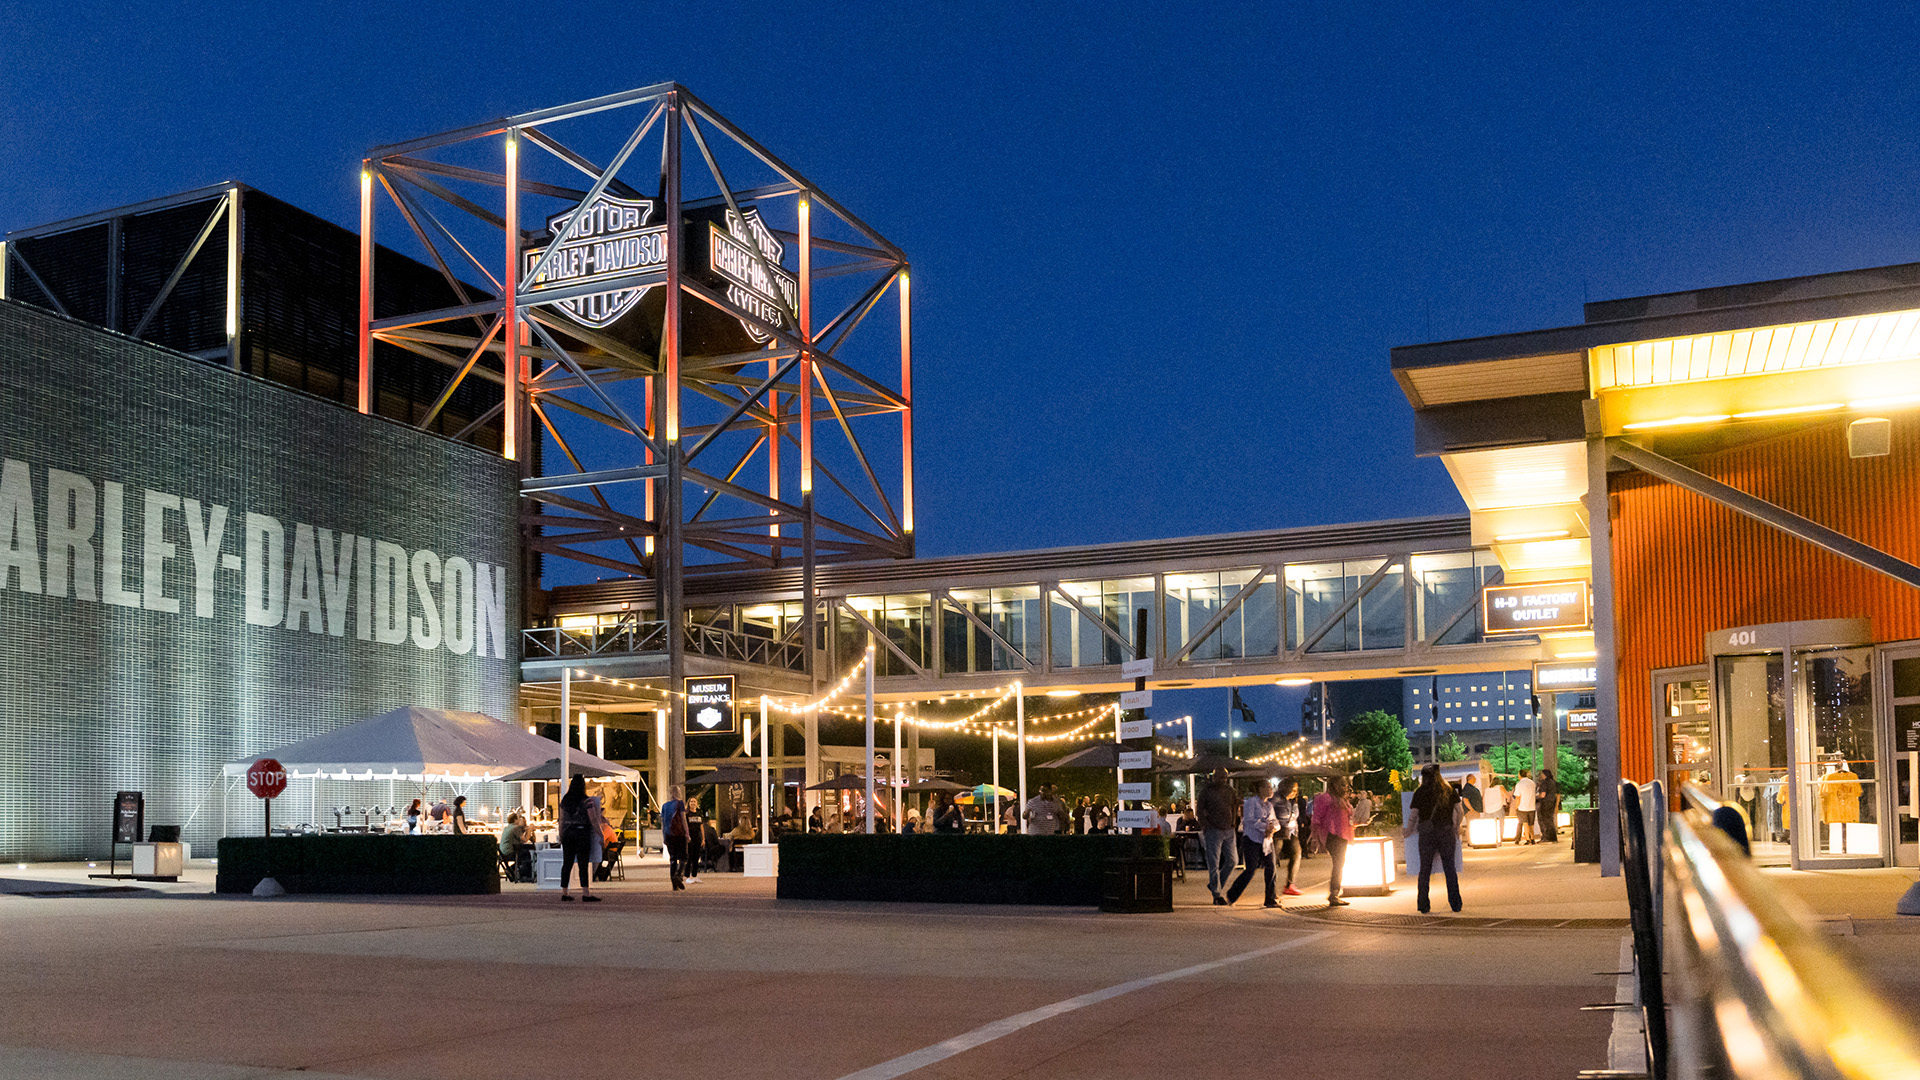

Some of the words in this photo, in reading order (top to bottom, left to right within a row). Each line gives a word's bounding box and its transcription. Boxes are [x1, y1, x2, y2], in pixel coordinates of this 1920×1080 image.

[1494, 596, 1518, 609] H-D
[1522, 592, 1577, 606] FACTORY
[1512, 608, 1559, 621] OUTLET
[1729, 630, 1756, 646] 401
[692, 684, 727, 693] MUSEUM
[688, 694, 731, 704] ENTRANCE
[250, 771, 284, 786] STOP
